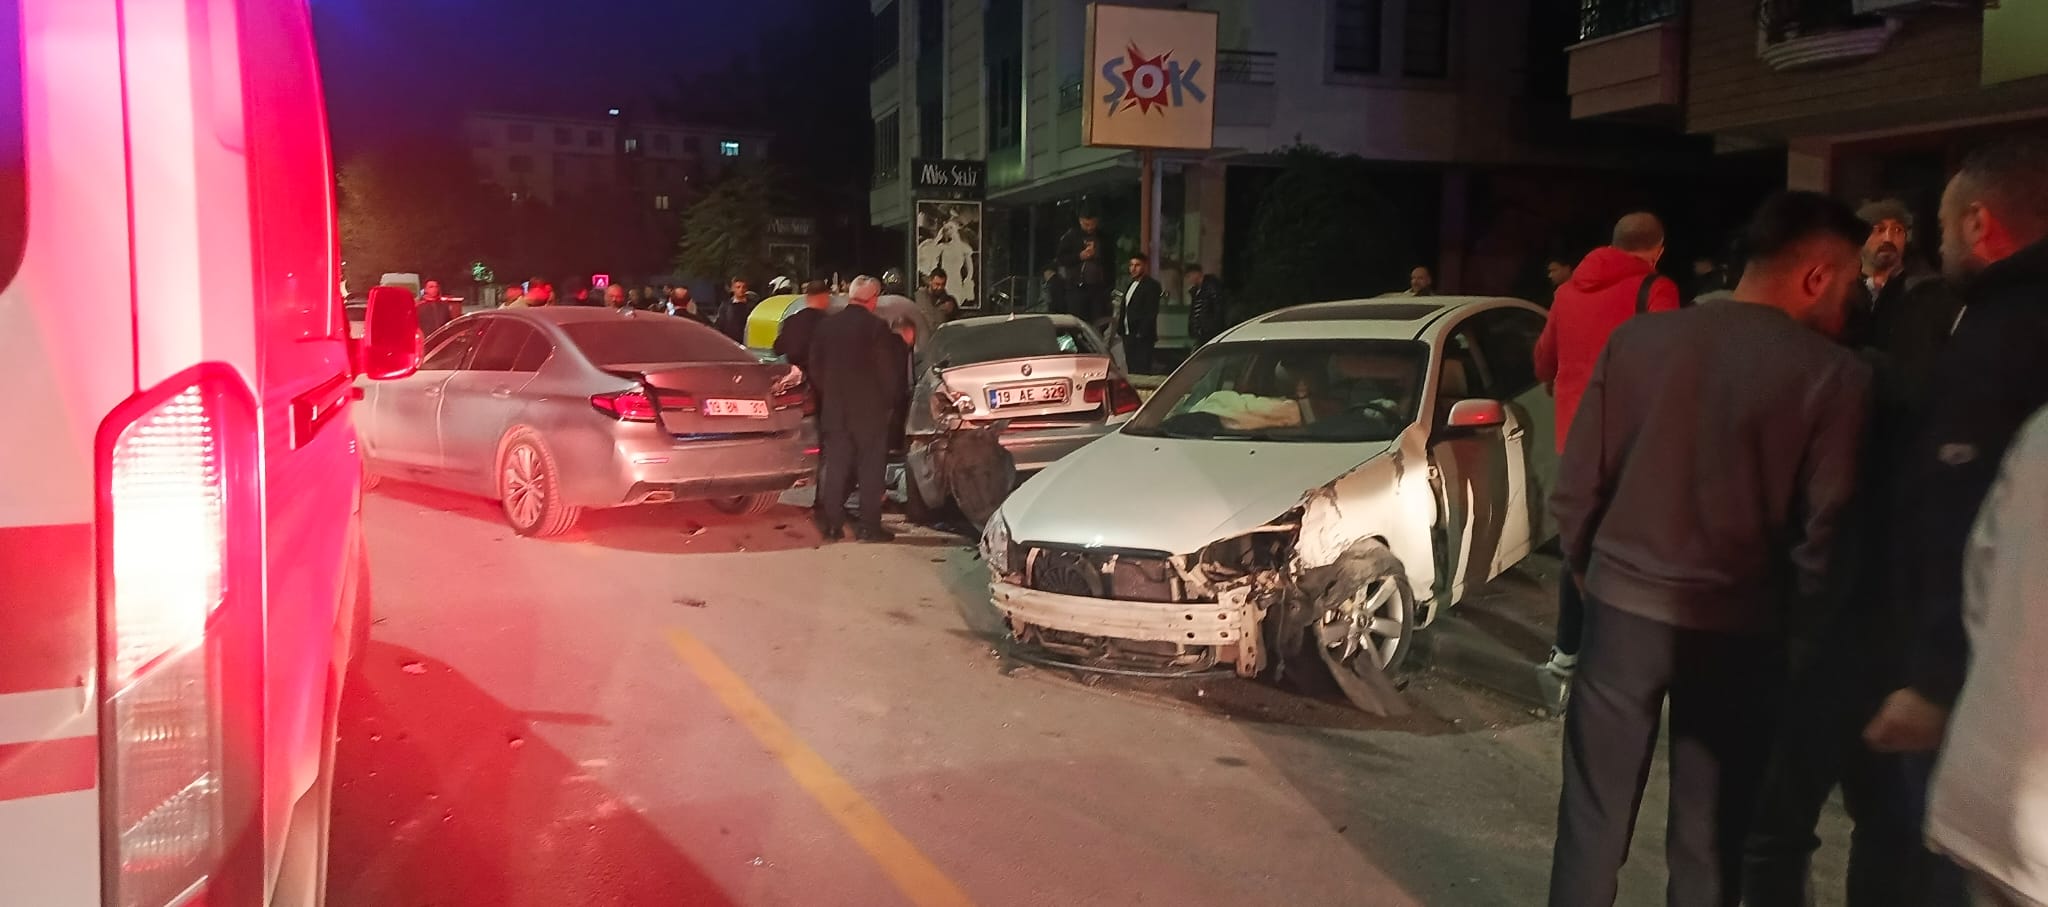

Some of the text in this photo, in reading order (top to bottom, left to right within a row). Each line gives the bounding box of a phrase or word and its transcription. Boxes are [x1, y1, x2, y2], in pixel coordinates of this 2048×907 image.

[1102, 55, 1206, 118] ŞOK
[998, 391, 1011, 403] 19
[1019, 389, 1035, 401] AE
